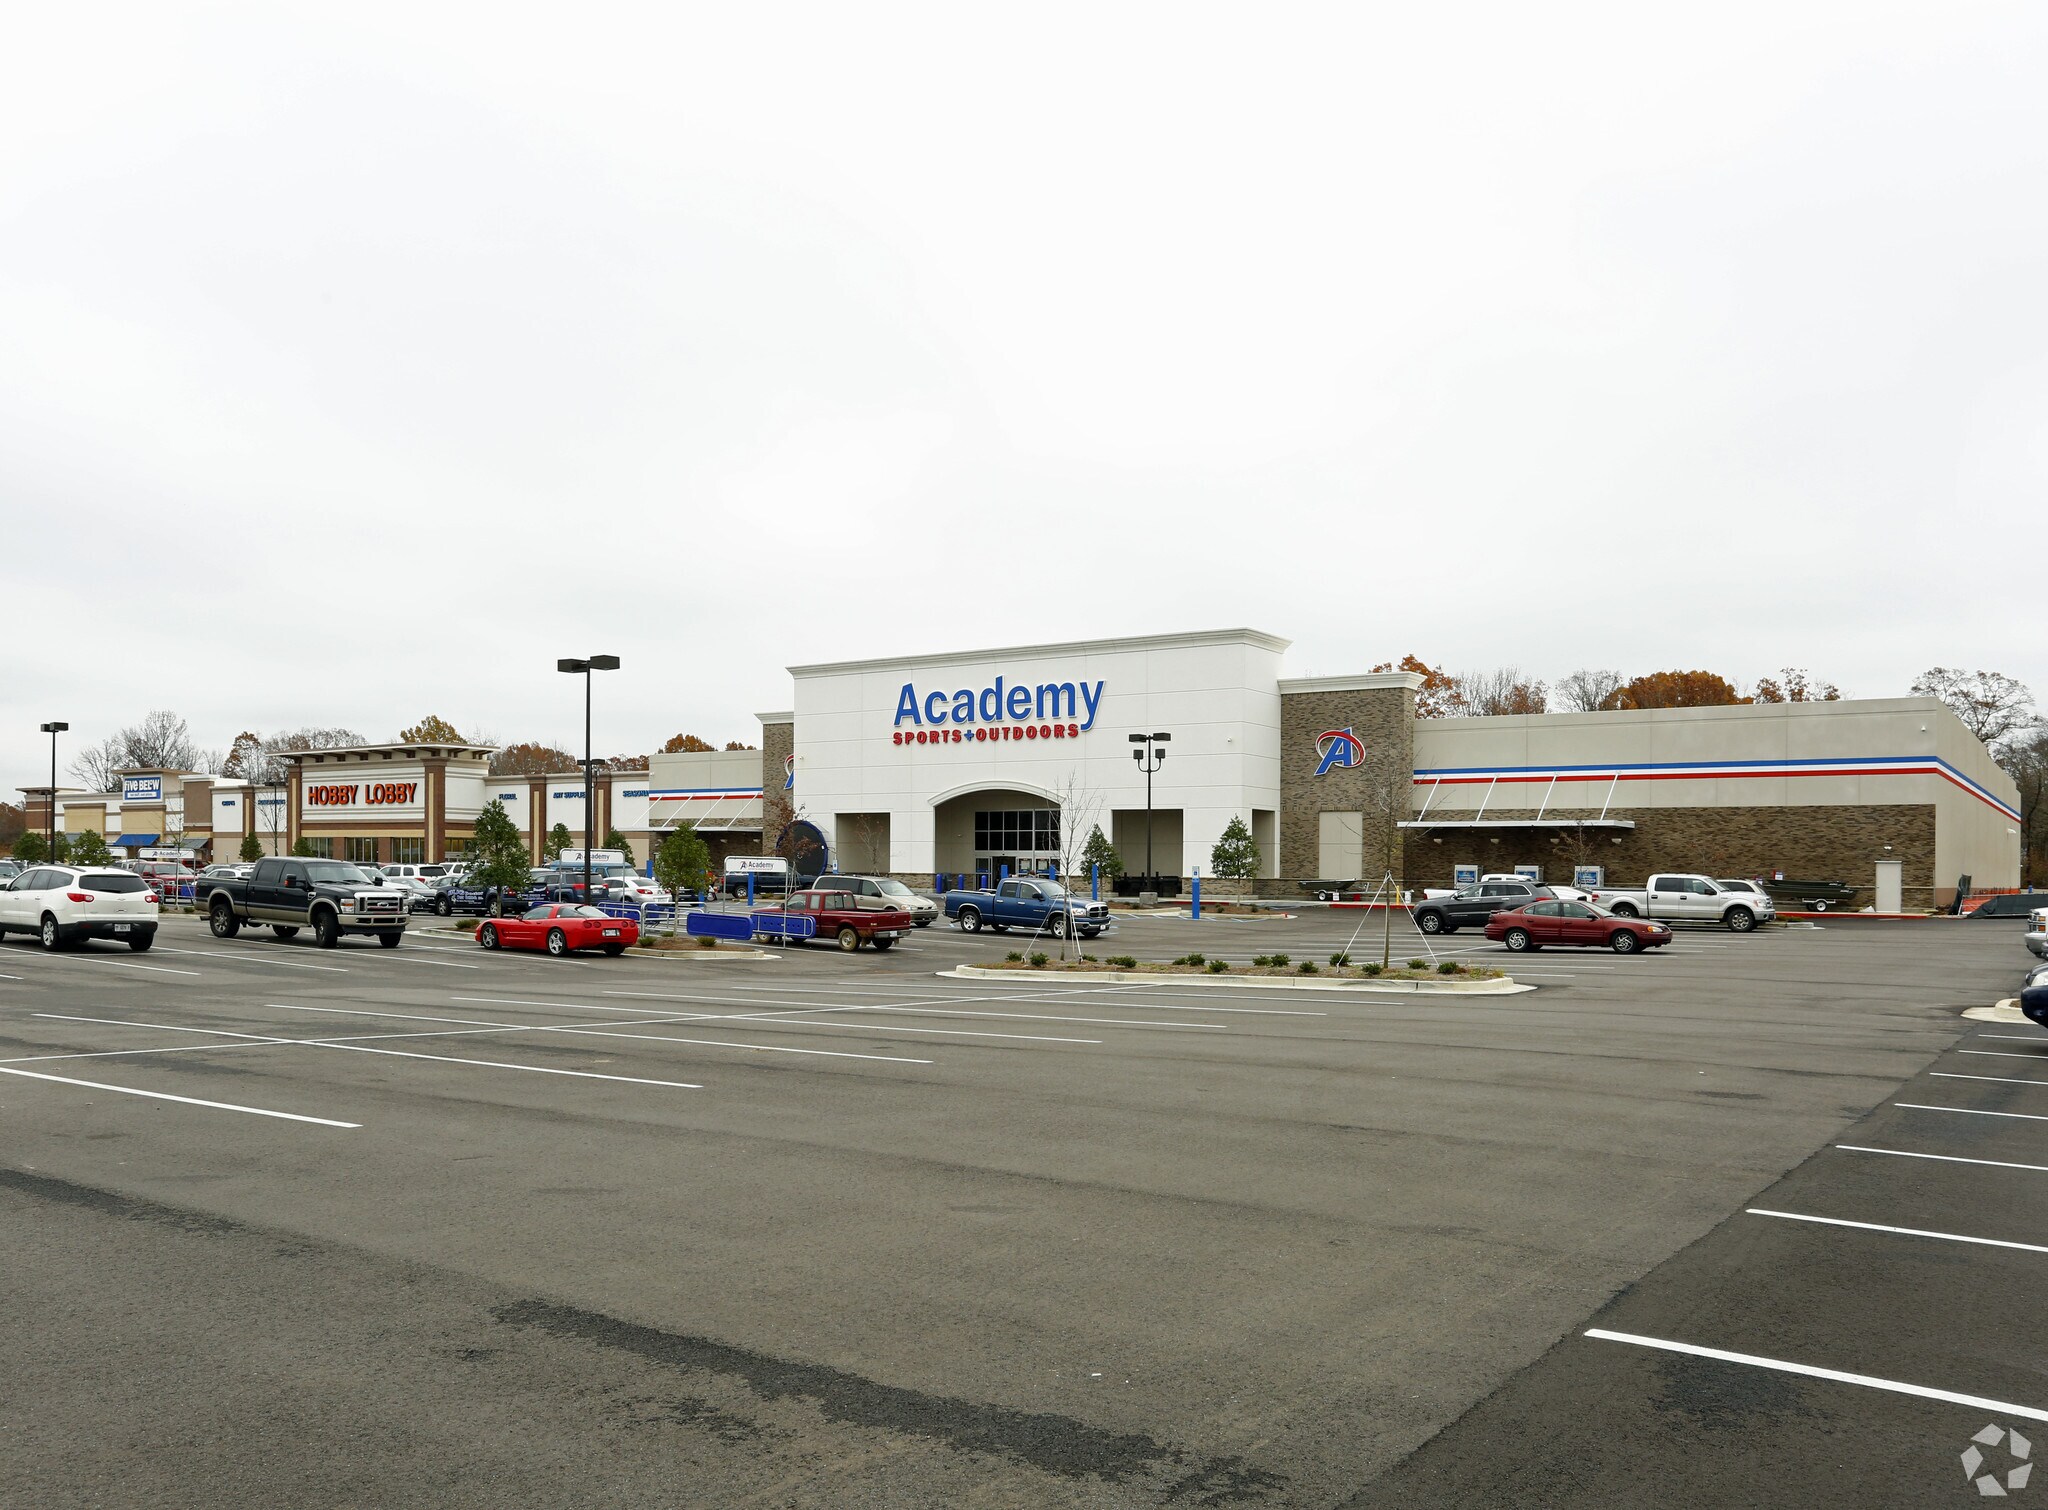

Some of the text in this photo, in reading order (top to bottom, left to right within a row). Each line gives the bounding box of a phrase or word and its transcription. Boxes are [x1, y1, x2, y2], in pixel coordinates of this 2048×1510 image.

[893, 675, 1106, 732] Academy
[892, 723, 1080, 745] SPORTS+OUTDOORS
[308, 782, 418, 806] HOBBY LOBBY
[564, 791, 586, 799] SUPPLIE
[748, 861, 774, 870] Academy
